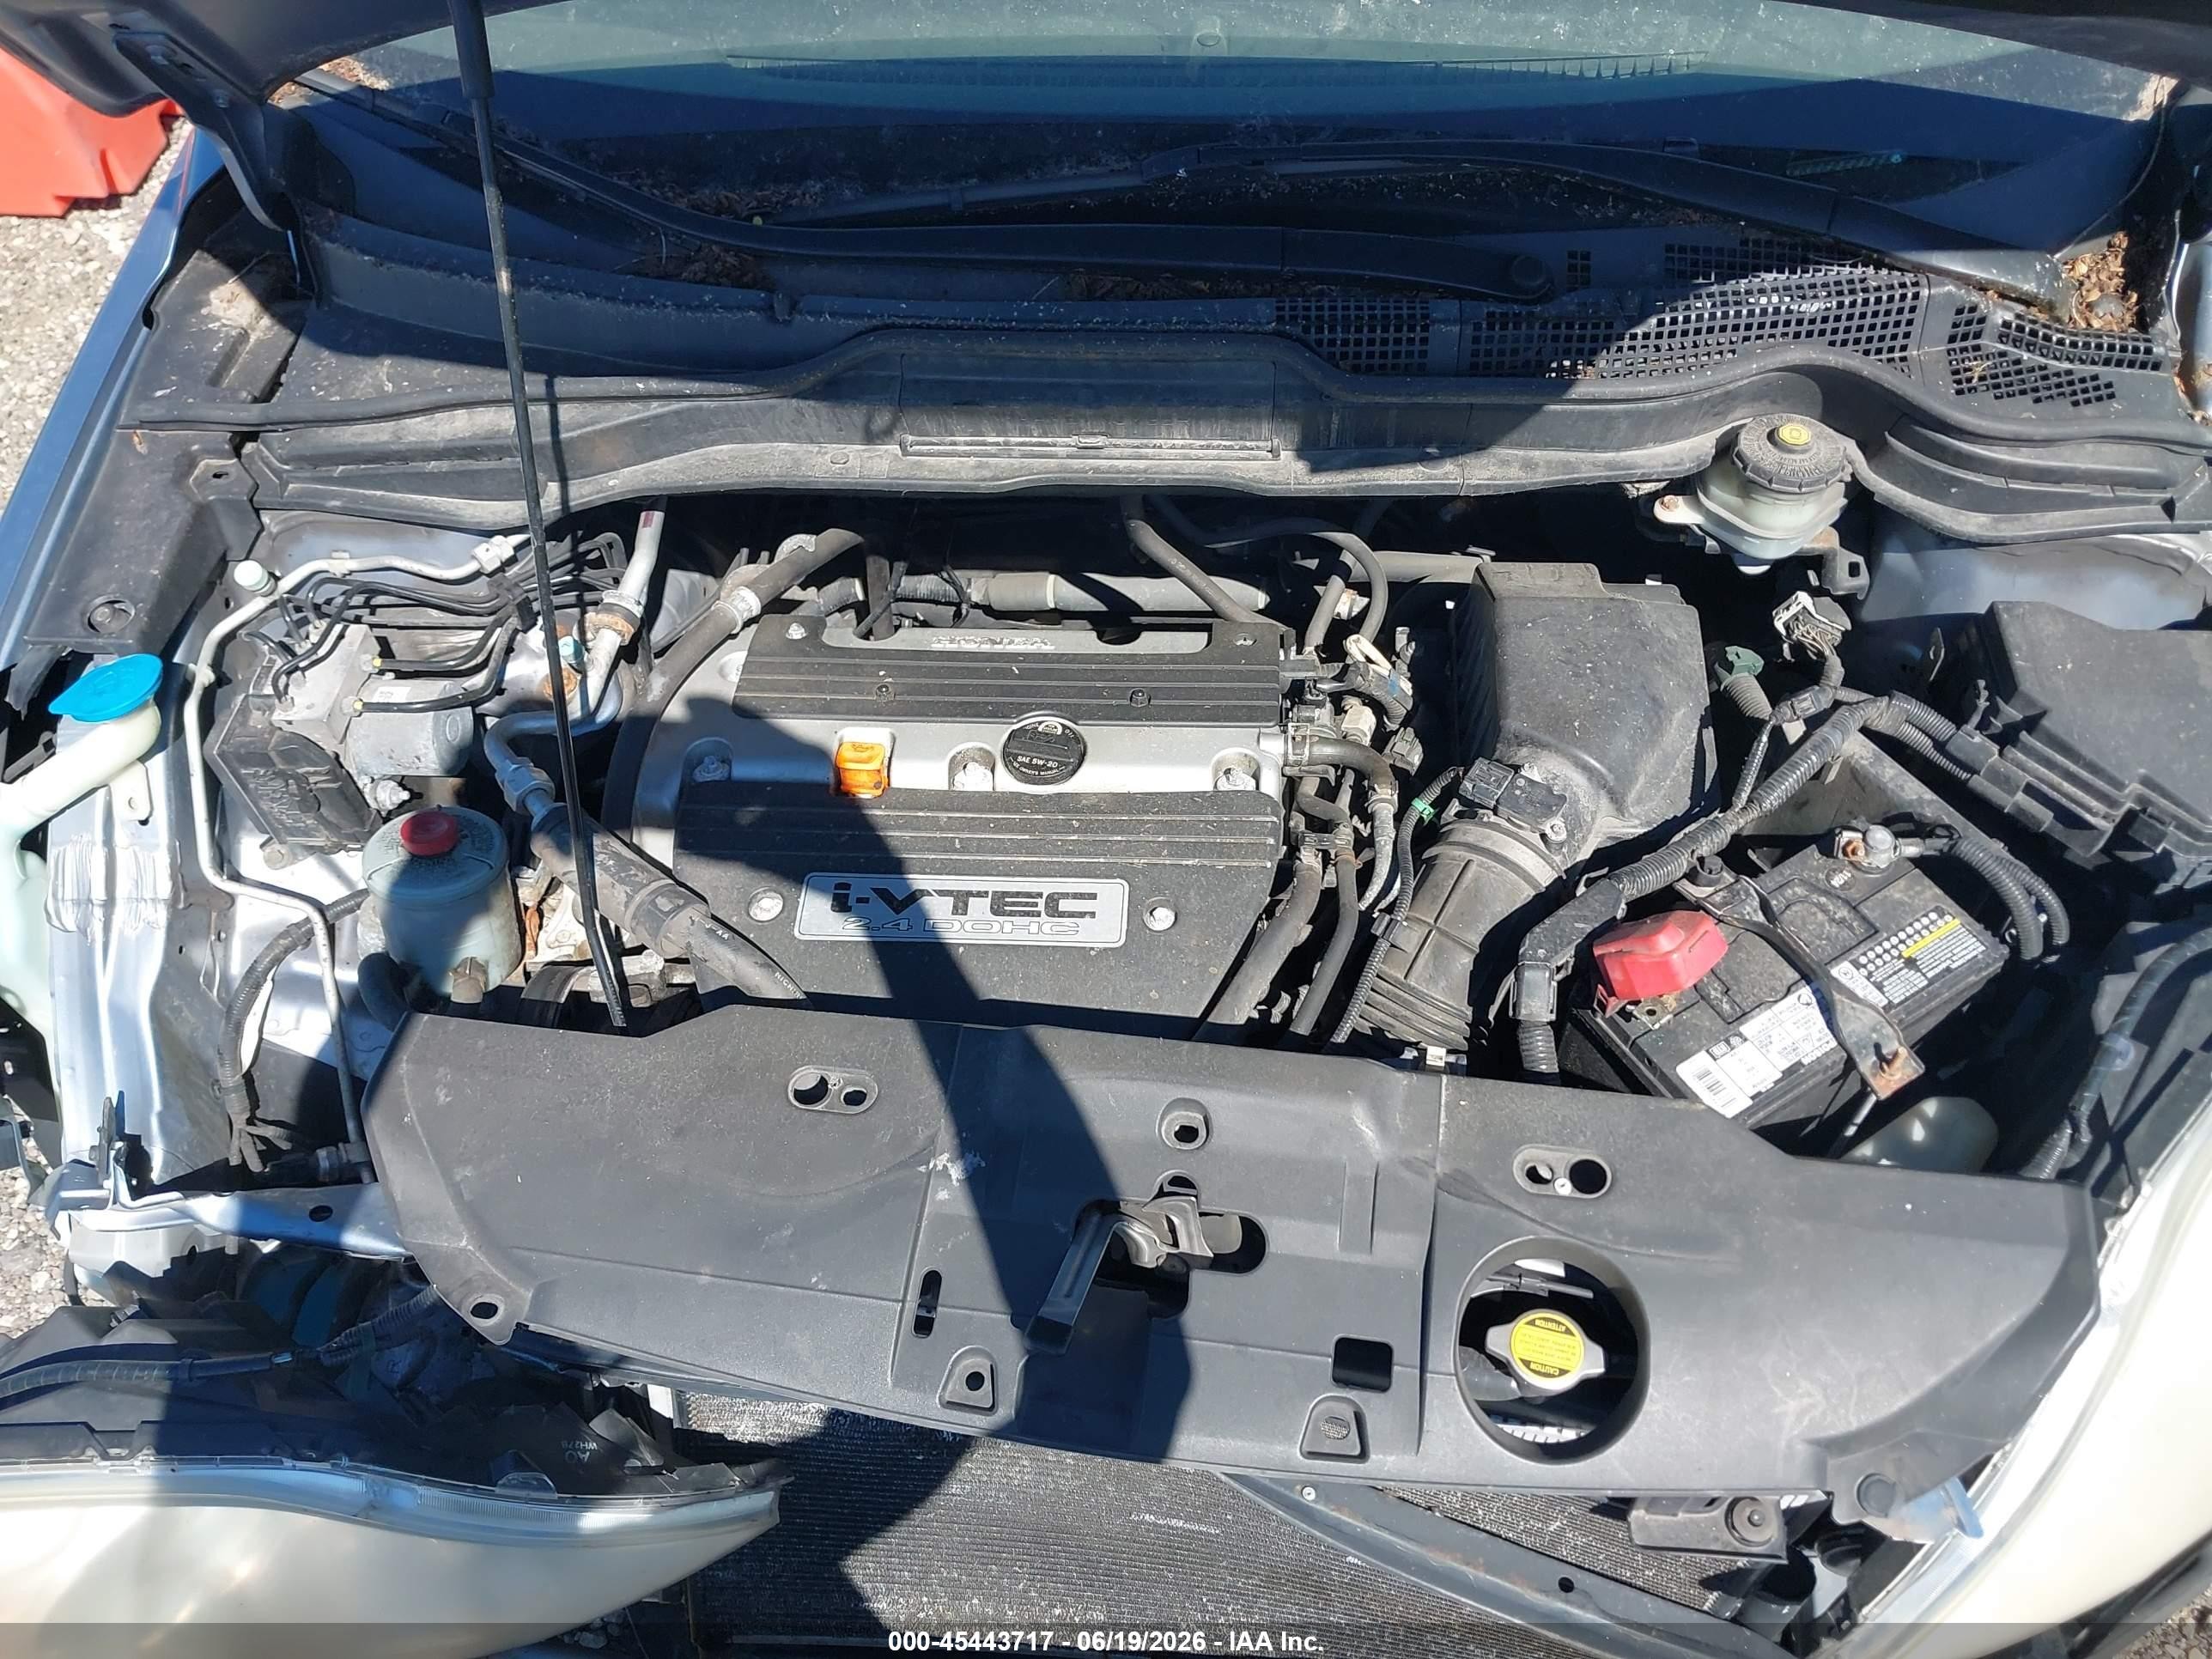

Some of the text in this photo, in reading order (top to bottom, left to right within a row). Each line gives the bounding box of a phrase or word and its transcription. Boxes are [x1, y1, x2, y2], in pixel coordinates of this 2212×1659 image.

[1031, 758, 1058, 768] 5W-20
[830, 882, 1098, 919] i-VTEC
[842, 916, 1080, 936] 2.4 DOHC
[1534, 1318, 1566, 1332] ATTENTION
[1529, 1361, 1559, 1376] CAUTION
